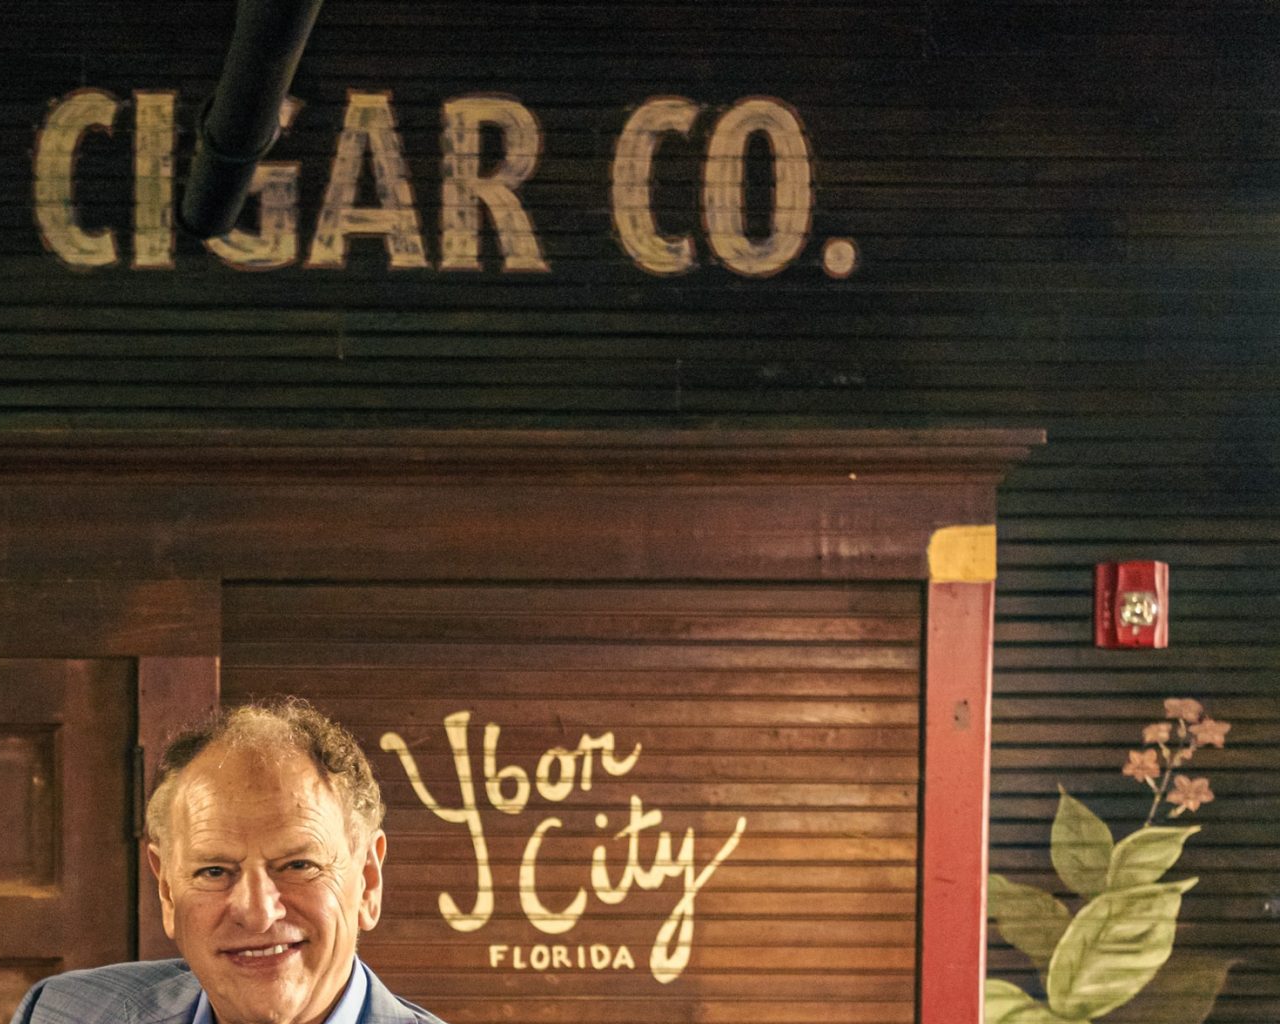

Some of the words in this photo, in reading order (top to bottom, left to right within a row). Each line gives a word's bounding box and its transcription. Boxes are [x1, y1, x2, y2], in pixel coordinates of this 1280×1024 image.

[611, 94, 859, 279] CO.
[380, 710, 643, 932] Ybor
[519, 795, 746, 984] City
[489, 944, 635, 970] FLORIDA
